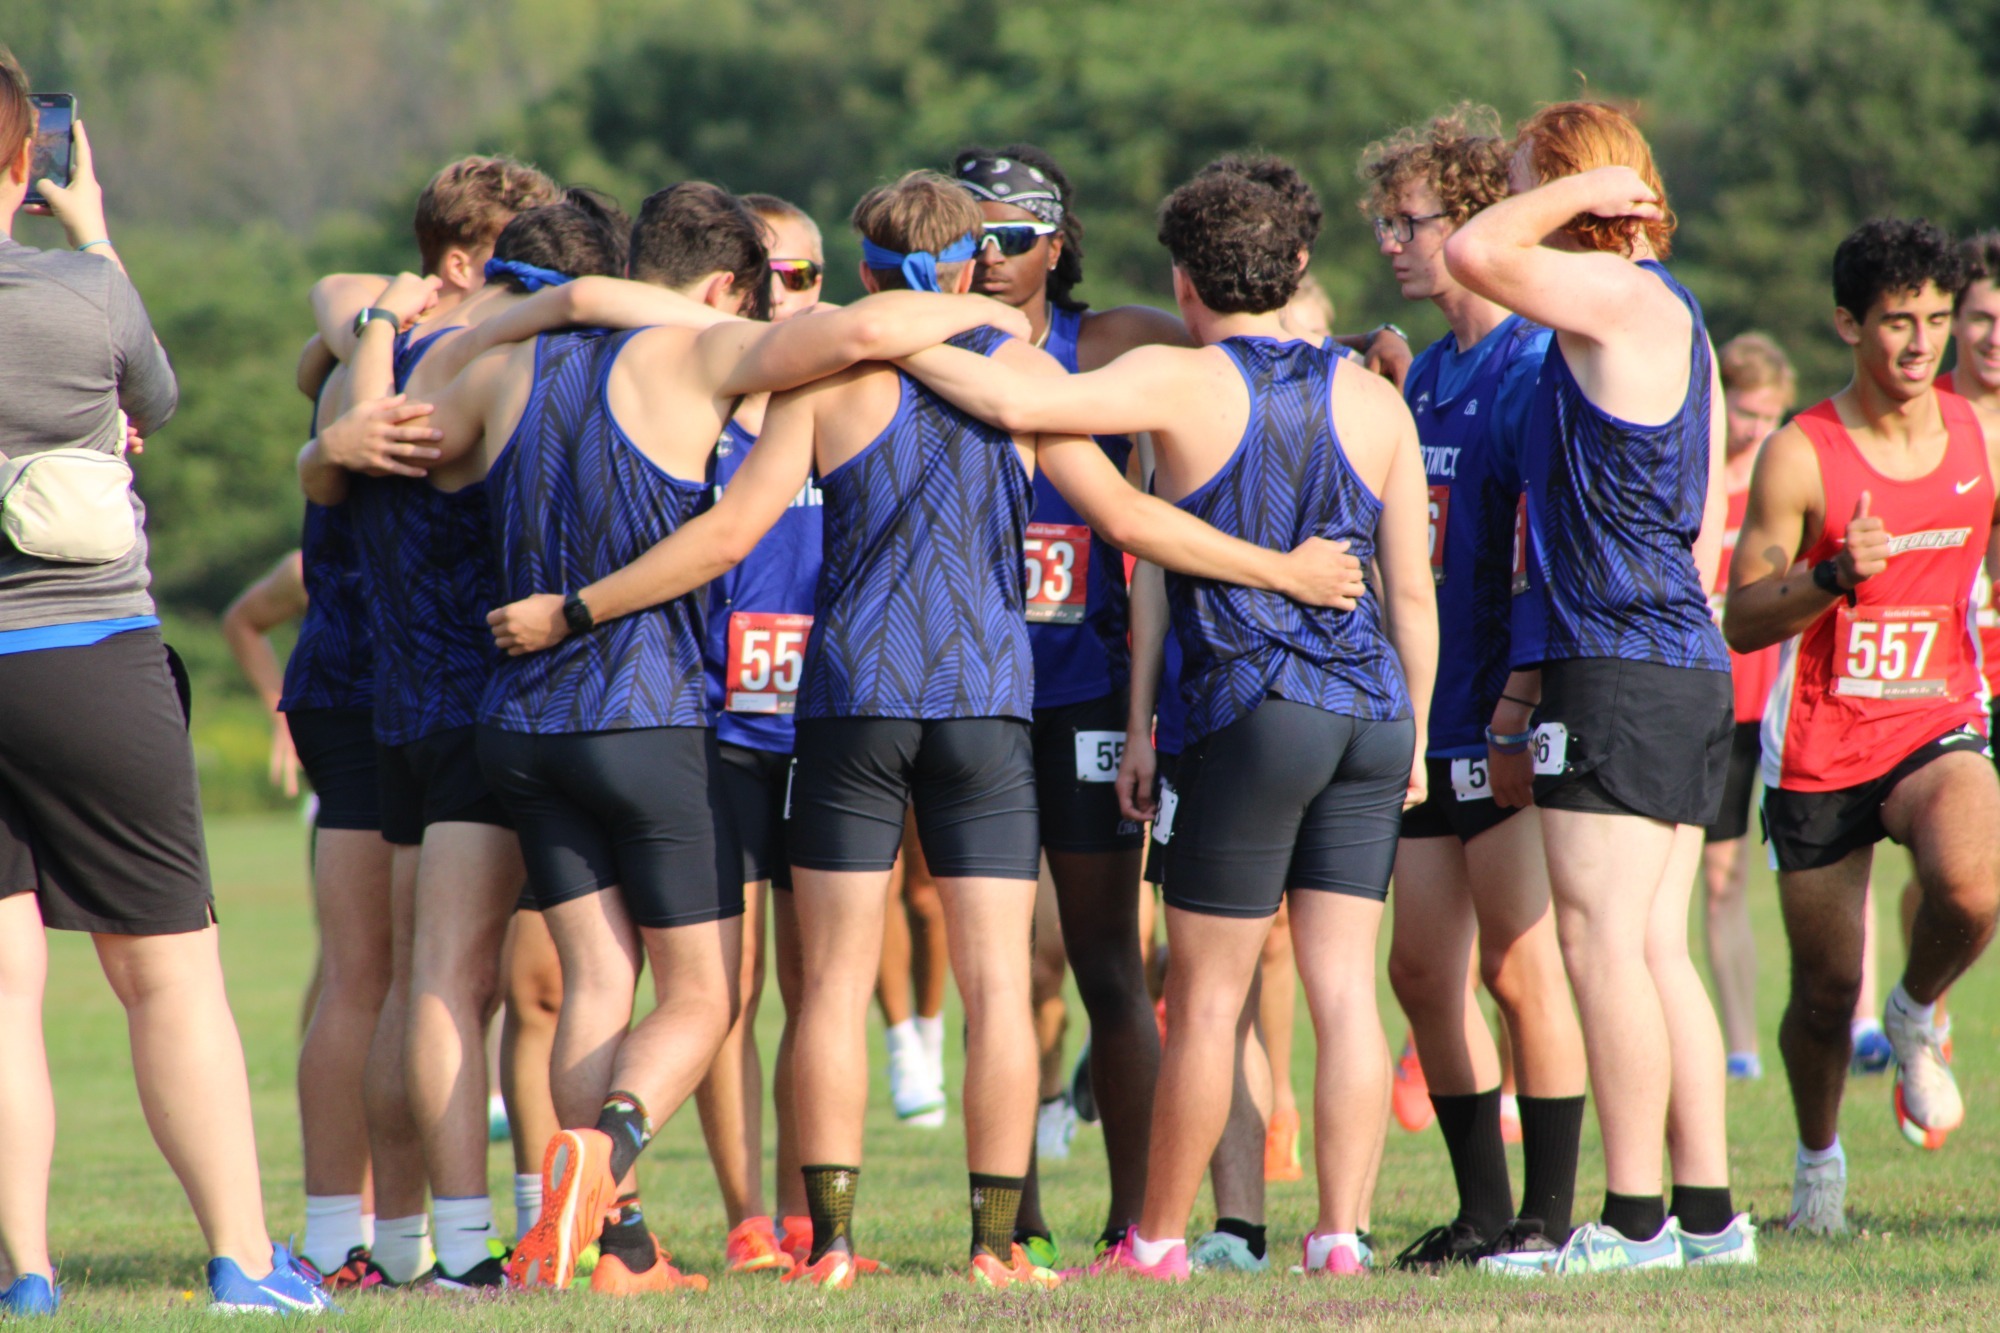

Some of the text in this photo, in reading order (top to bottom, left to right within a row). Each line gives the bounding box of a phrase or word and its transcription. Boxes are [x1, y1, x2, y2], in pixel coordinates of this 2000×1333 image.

[1024, 541, 1075, 602] 53
[741, 630, 803, 693] 55
[1847, 622, 1939, 679] 557
[1096, 741, 1126, 771] 55
